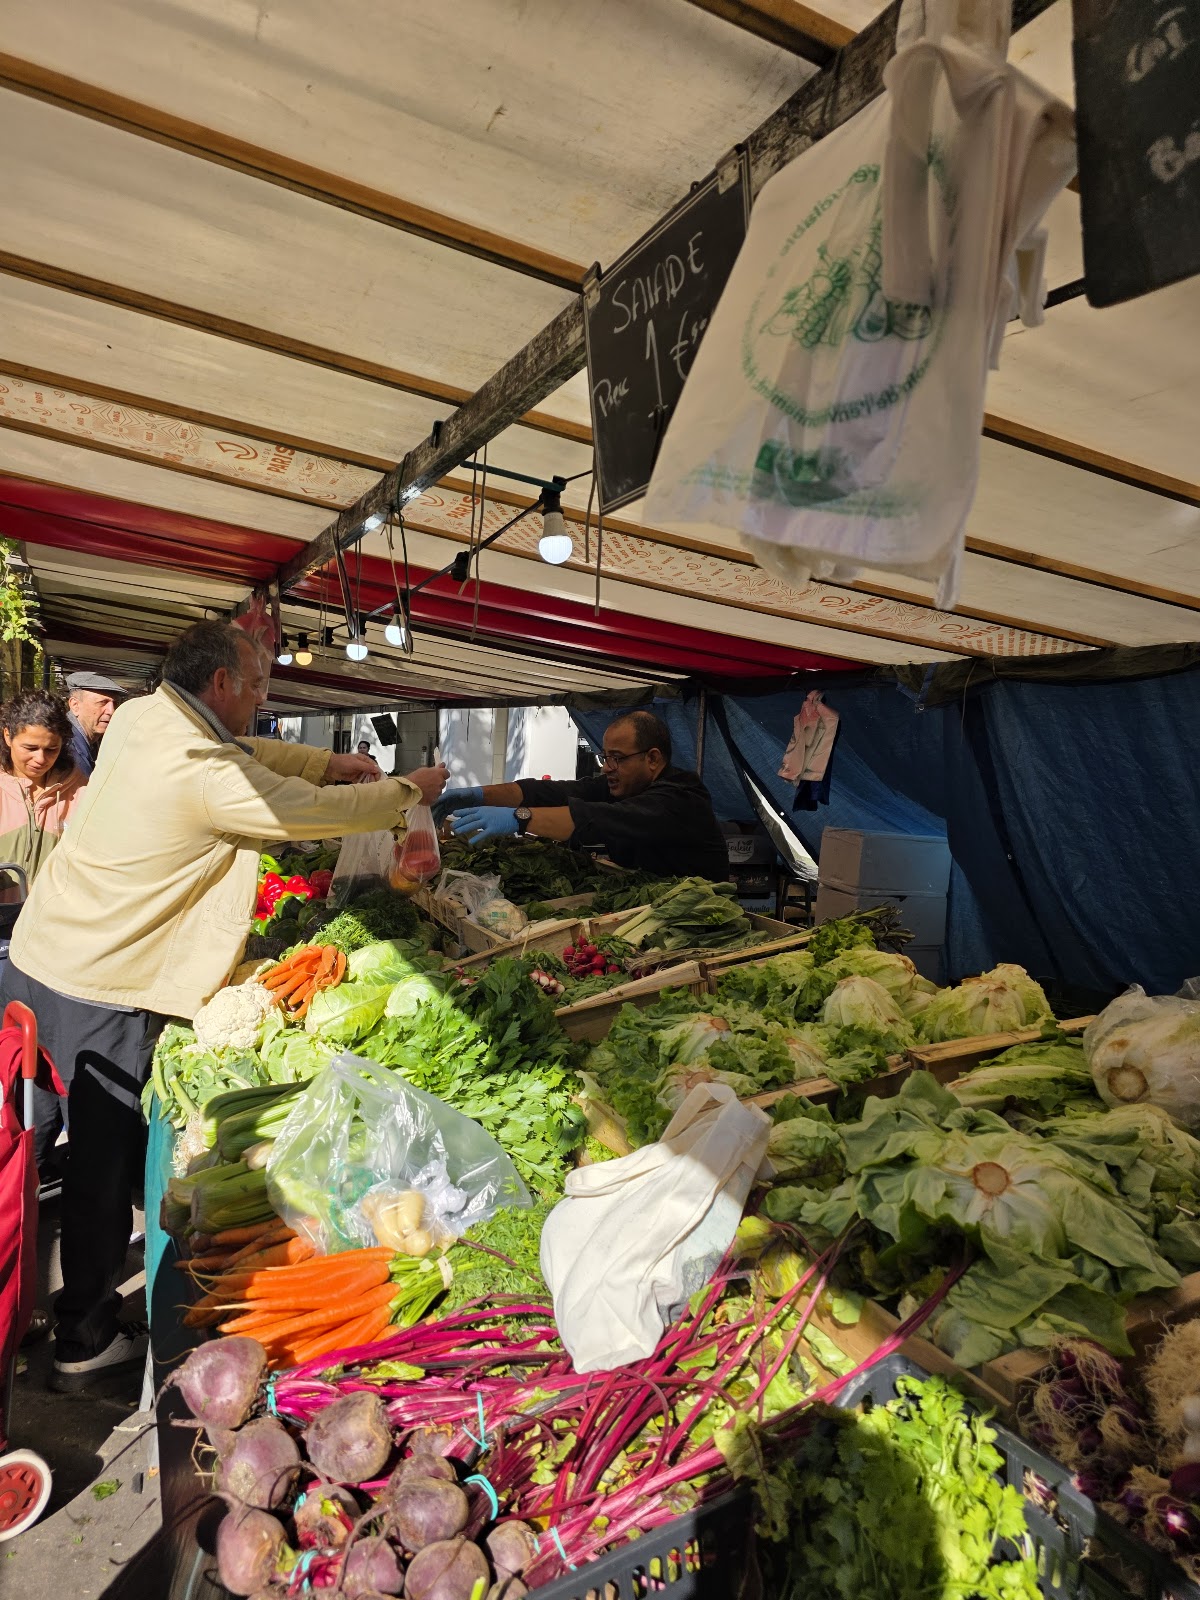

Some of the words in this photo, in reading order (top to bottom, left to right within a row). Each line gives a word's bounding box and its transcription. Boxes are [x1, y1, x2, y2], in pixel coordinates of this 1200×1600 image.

[266, 445, 296, 475] PARIS
[446, 495, 481, 520] PARIS
[838, 597, 884, 615] PARIS
